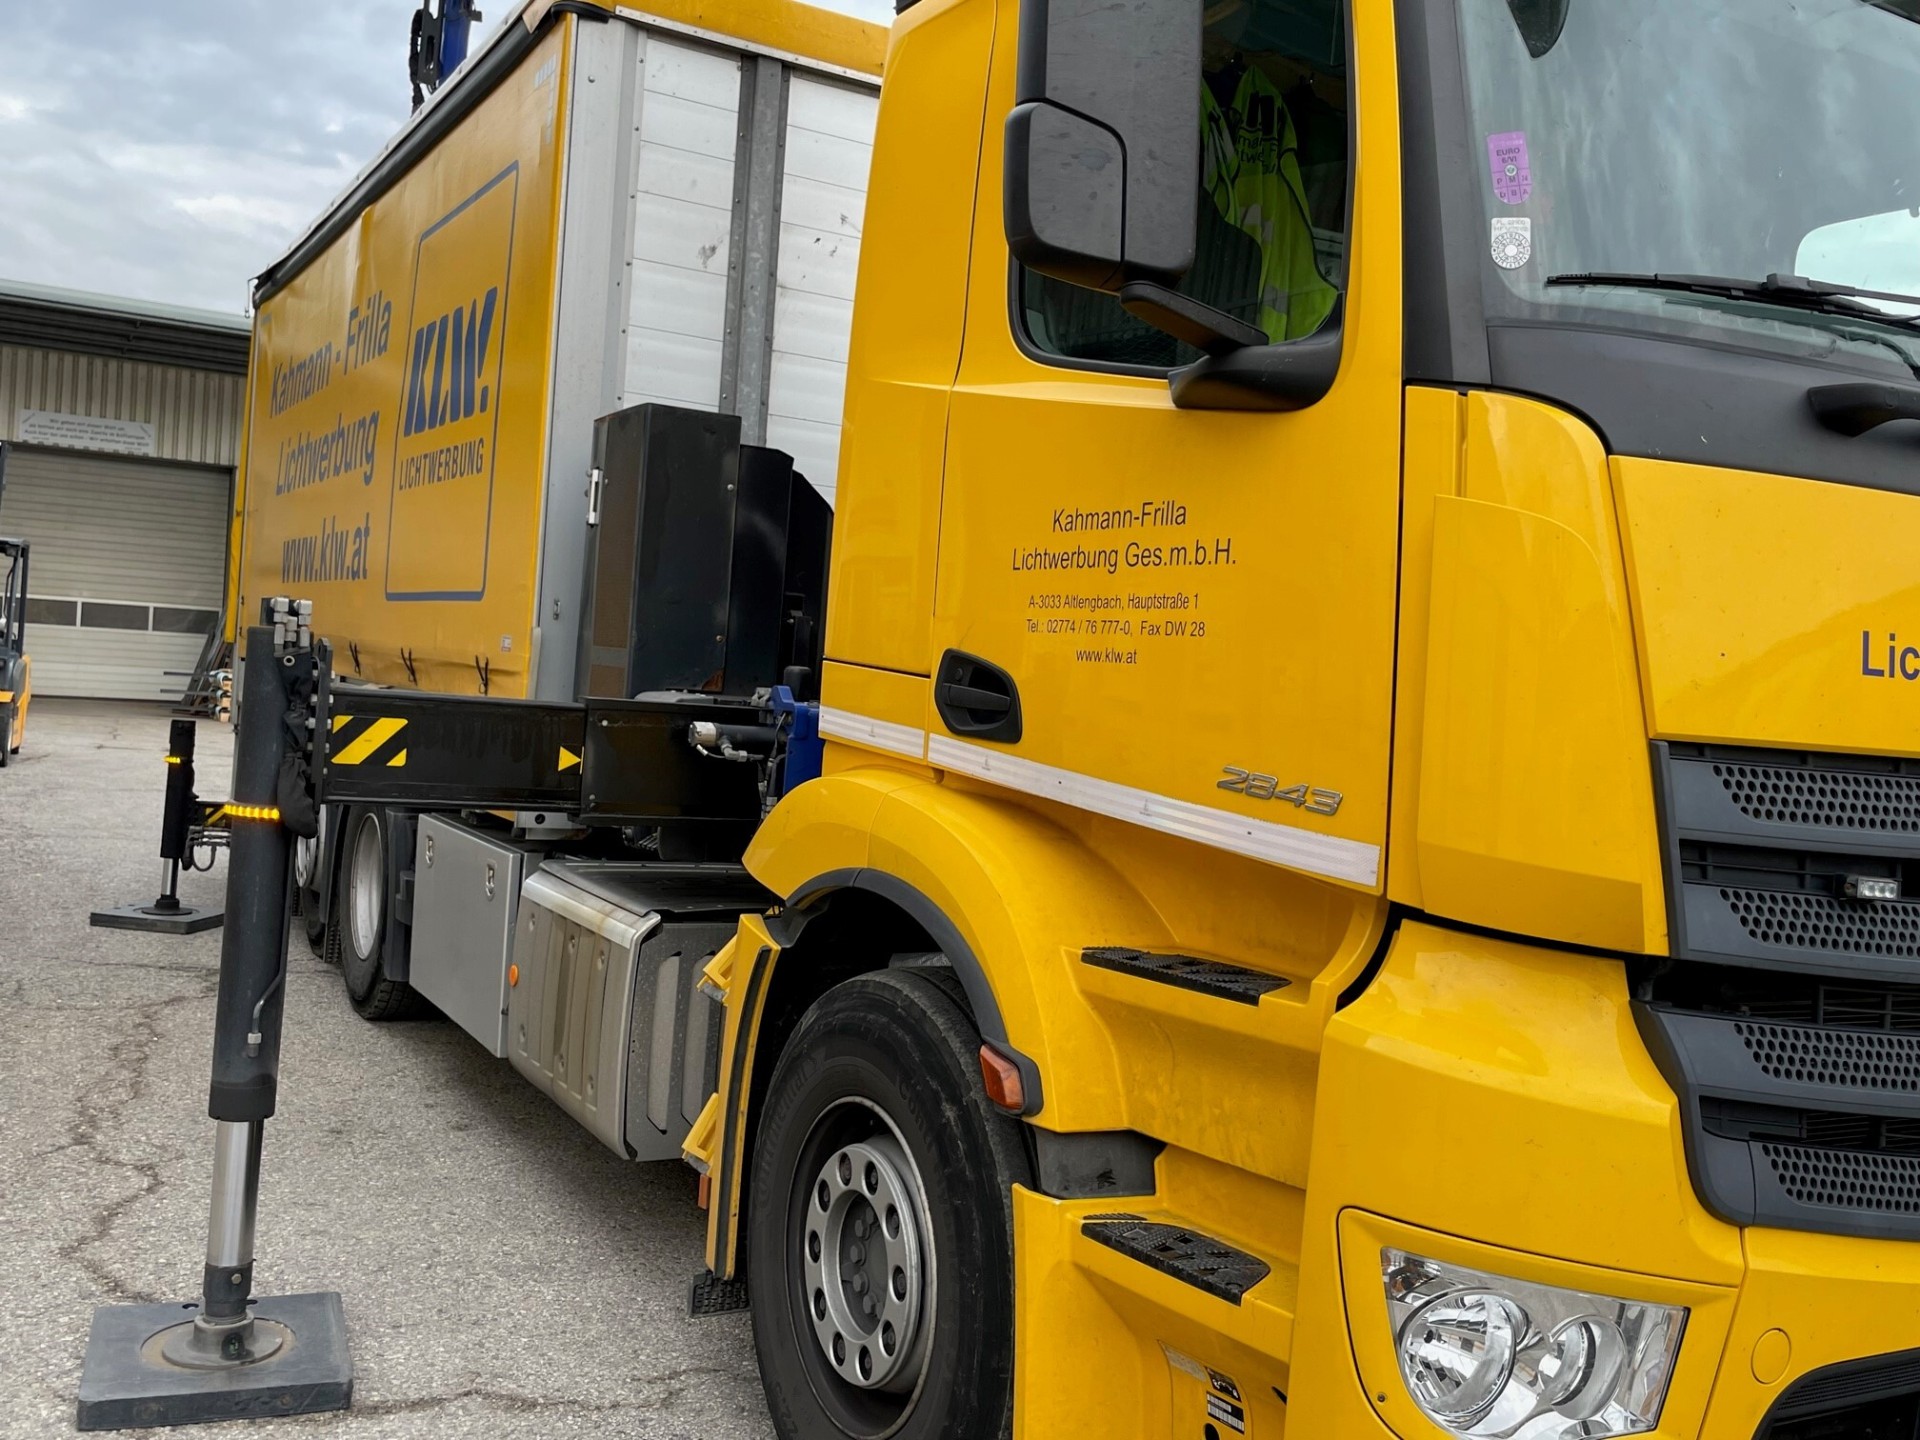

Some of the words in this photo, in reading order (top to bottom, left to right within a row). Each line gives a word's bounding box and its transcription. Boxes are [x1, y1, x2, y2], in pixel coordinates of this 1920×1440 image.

[1496, 147, 1520, 157] EURO
[270, 341, 332, 419] Kahmann
[343, 290, 392, 376] Frilla
[276, 410, 380, 496] Lichtwerbung
[399, 437, 484, 491] LICHTWERBUNG
[1052, 500, 1187, 533] Kahmann-Frilla
[281, 512, 370, 584] www.klw.at
[1011, 544, 1118, 575] Lichtwerbung
[1124, 537, 1237, 568] Ges.m.b.H.
[1028, 594, 1062, 610] A-3033
[1064, 593, 1124, 612] Altlengbach,
[1127, 592, 1189, 612] Hauptstraße
[1193, 593, 1199, 610] 1
[1046, 619, 1075, 634] 02774
[1085, 619, 1097, 635] 76
[1140, 620, 1161, 636] Fax
[1165, 621, 1188, 637] DW
[1190, 621, 1205, 637] 28
[1076, 648, 1137, 664] www.klw.at
[1862, 630, 1920, 681] Lic
[1216, 765, 1343, 816] 2843
